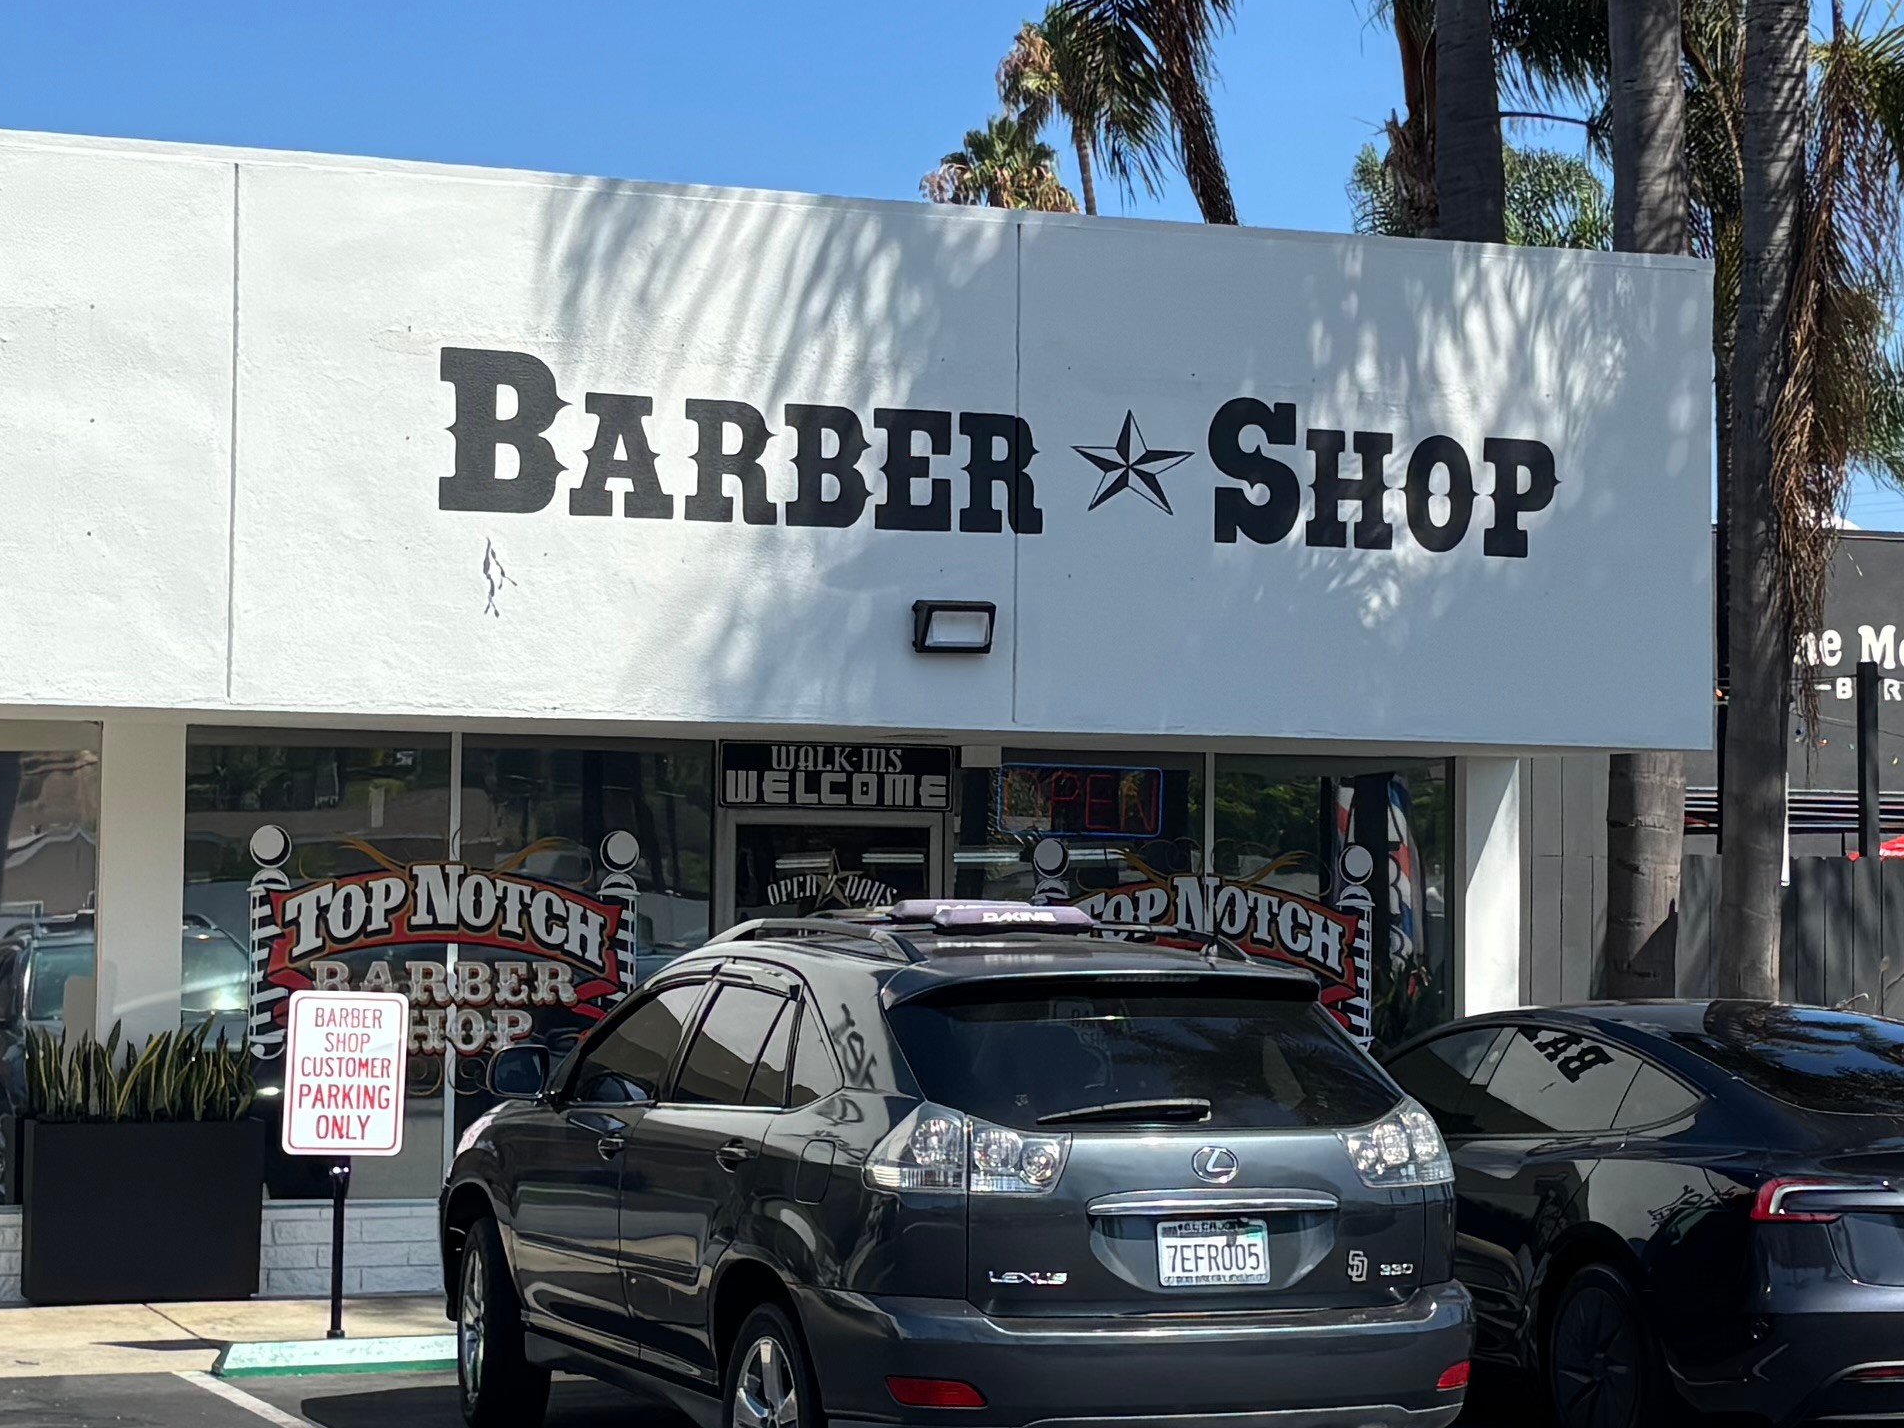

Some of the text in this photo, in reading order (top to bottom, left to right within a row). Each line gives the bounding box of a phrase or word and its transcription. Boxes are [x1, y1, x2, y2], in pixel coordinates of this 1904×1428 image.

[437, 345, 1561, 559] BARBER SHOP
[725, 769, 949, 807] WELCOME
[284, 864, 605, 968] TOP NOTCH
[1170, 876, 1345, 971] NOTCH
[310, 960, 579, 1008] BARBER
[314, 1007, 383, 1030] BARBER
[407, 1009, 533, 1056] HOP
[324, 1032, 371, 1053] SHOP
[300, 1056, 391, 1079] CUSTOMER
[298, 1083, 390, 1110] PARKING
[315, 1114, 371, 1141] ONLY
[1166, 1243, 1260, 1273] 7EFR005
[988, 1271, 1068, 1285] LEXUS
